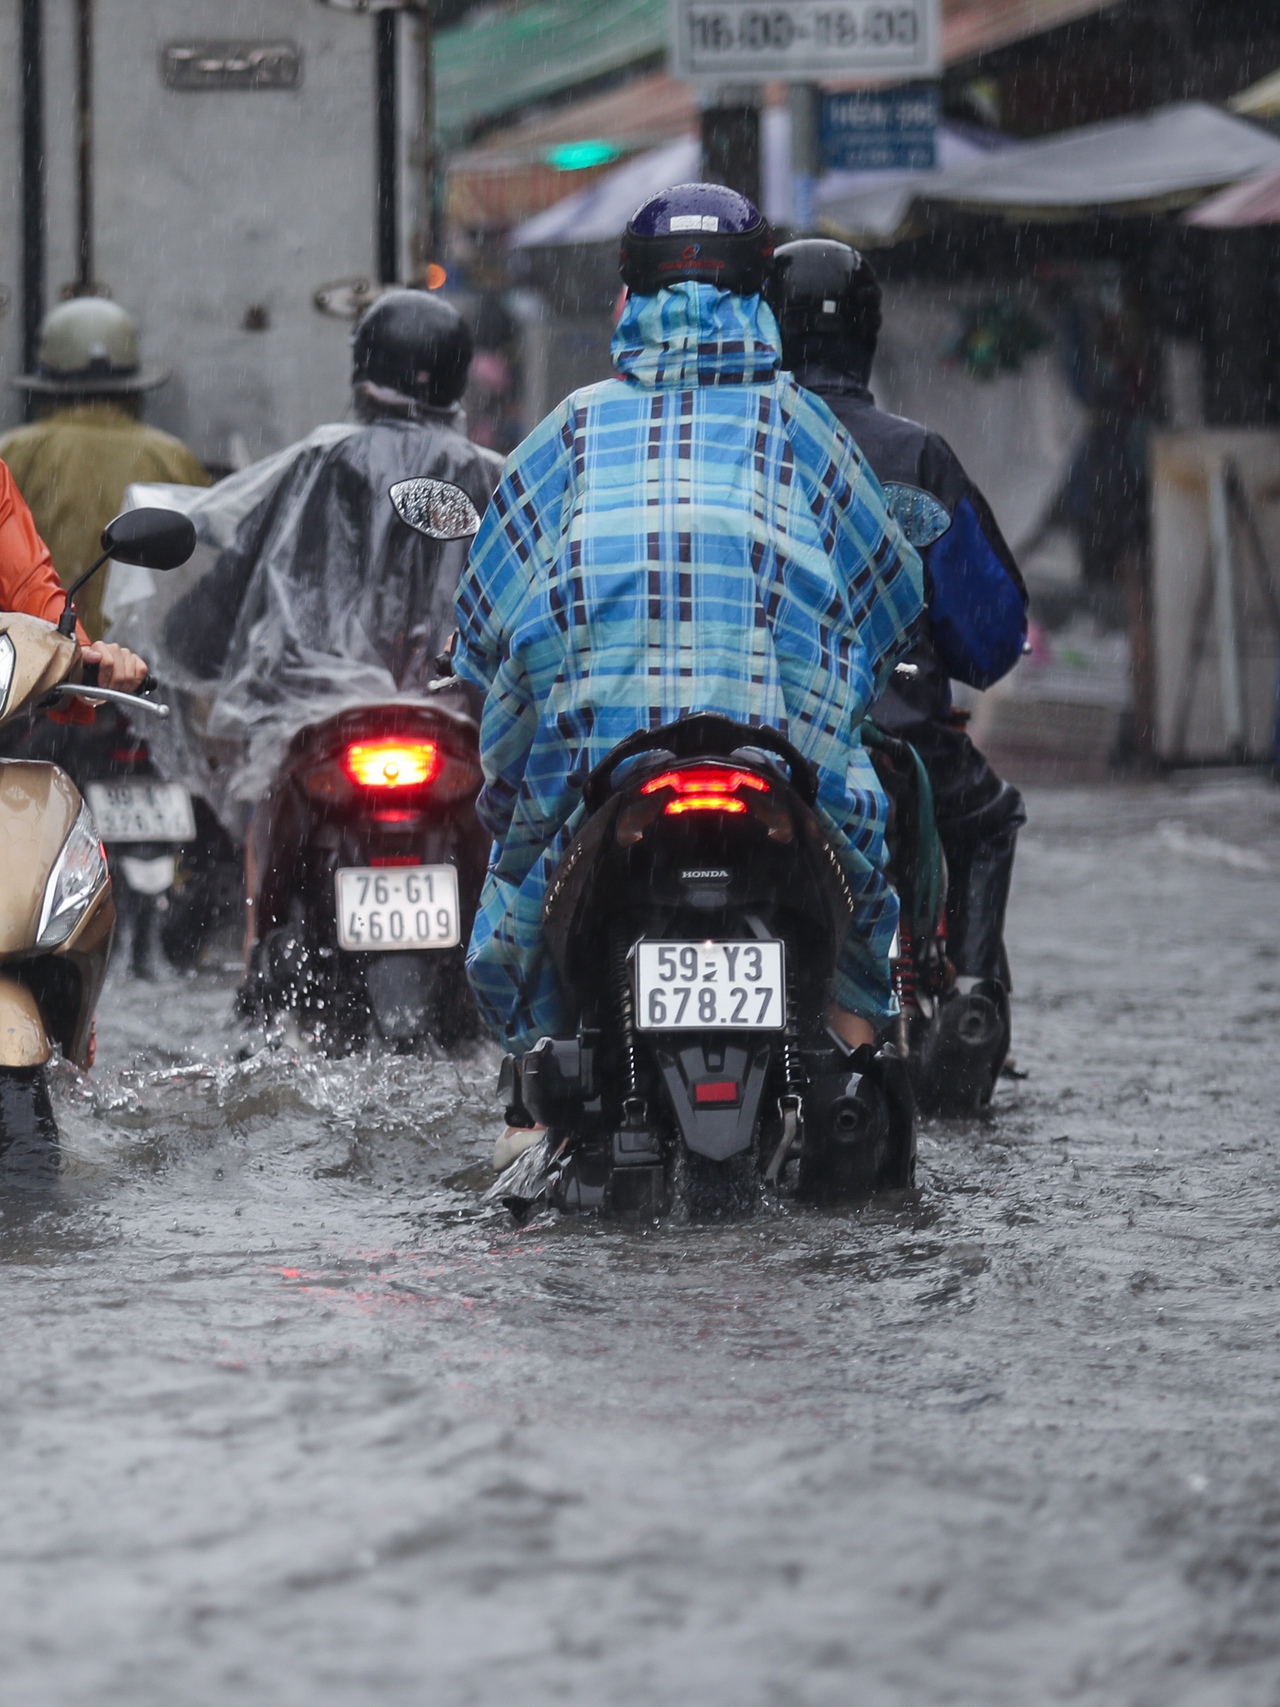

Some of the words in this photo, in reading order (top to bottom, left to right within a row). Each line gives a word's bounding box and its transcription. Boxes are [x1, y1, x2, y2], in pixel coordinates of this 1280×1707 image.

[682, 870, 729, 879] HONDA
[348, 908, 451, 944] 460.09
[657, 946, 763, 983] 59-Y3
[648, 986, 774, 1025] 678.27
